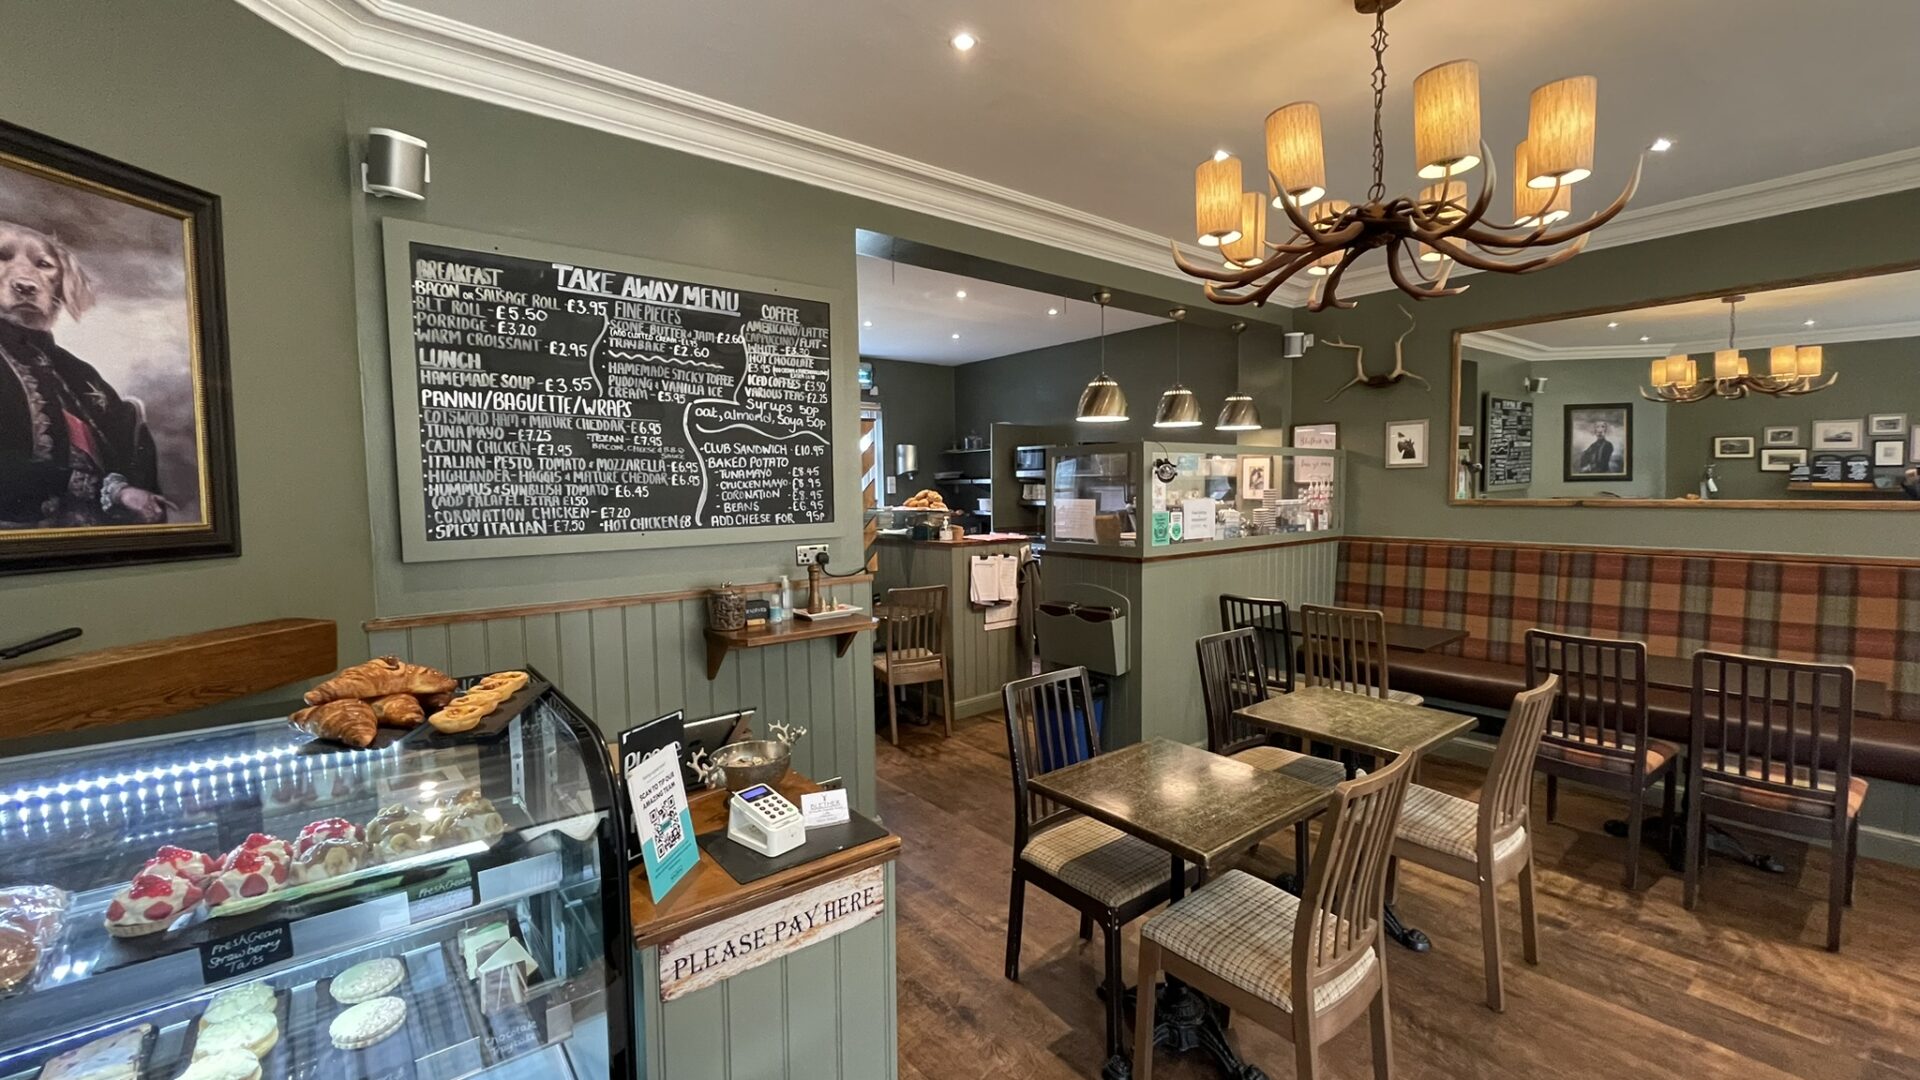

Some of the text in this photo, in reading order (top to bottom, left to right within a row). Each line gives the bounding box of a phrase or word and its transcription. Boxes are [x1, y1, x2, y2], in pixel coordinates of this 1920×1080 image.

[416, 259, 504, 286] BREAKFAST
[415, 280, 459, 299] BACON
[475, 288, 529, 306] SAUSAGE
[532, 295, 561, 311] ROLL
[552, 263, 739, 312] TAKE AWAY MENU
[415, 296, 446, 312] BLT
[452, 301, 487, 318] ROLL
[761, 304, 799, 324] COFFEE
[416, 312, 488, 332] PORRIDGE
[610, 319, 644, 333] SCONE
[650, 324, 686, 339] BUTTER
[692, 329, 715, 343] JAM
[417, 328, 461, 345] WARM
[467, 332, 543, 352] CROISSANT
[748, 343, 778, 354] WHITE
[419, 348, 482, 369] LUNCH
[749, 355, 814, 369] HOT CHOCOLATE
[420, 369, 499, 388] HAMEMADE
[500, 373, 536, 390] SOUP
[608, 362, 735, 387] HAMEMADE STICKY TOFFEE
[748, 374, 767, 386] ICED
[608, 375, 652, 390] PUDDING
[662, 380, 705, 396] VANILLA
[707, 386, 723, 398] ICE
[608, 387, 648, 400] CREAM
[744, 386, 783, 399] VARIOUS
[784, 390, 805, 401] TEAS
[746, 398, 819, 418] Syrups 50p
[424, 410, 489, 426] COTSWOLD
[492, 412, 519, 428] HAM
[529, 415, 573, 430] MATURE
[424, 424, 465, 439] TUNA
[466, 425, 504, 440] MAYO
[425, 439, 472, 453] CAJUN
[704, 442, 731, 454] CLUB
[734, 443, 787, 455] SANDWICH
[538, 458, 586, 471] TOMATO
[708, 457, 789, 468] BAKED POTATO
[573, 471, 618, 484] MATURE
[720, 480, 761, 490] CHICKEN
[762, 479, 788, 489] MAYO
[428, 484, 492, 496] HUMMUS
[501, 484, 562, 496] SUNBLUSH
[566, 484, 608, 496] TOMATO
[721, 489, 780, 500] CORONATION
[467, 496, 522, 507] FALAFEL
[524, 496, 560, 507] EXTRA
[724, 501, 760, 513] BEANS
[434, 508, 525, 523] CORONATION
[532, 507, 589, 520] CHICKEN
[711, 515, 735, 527] ADD
[735, 513, 771, 525] CHEESE
[775, 513, 795, 524] FOR
[435, 523, 479, 539] SPICY
[483, 520, 547, 537] ITALIAN
[604, 518, 627, 532] HOT
[630, 515, 678, 530] CHICKEN
[639, 788, 652, 801] SCAN
[643, 781, 675, 809] AMAZING TEAM
[674, 887, 875, 980] PLEASE PAY HERE
